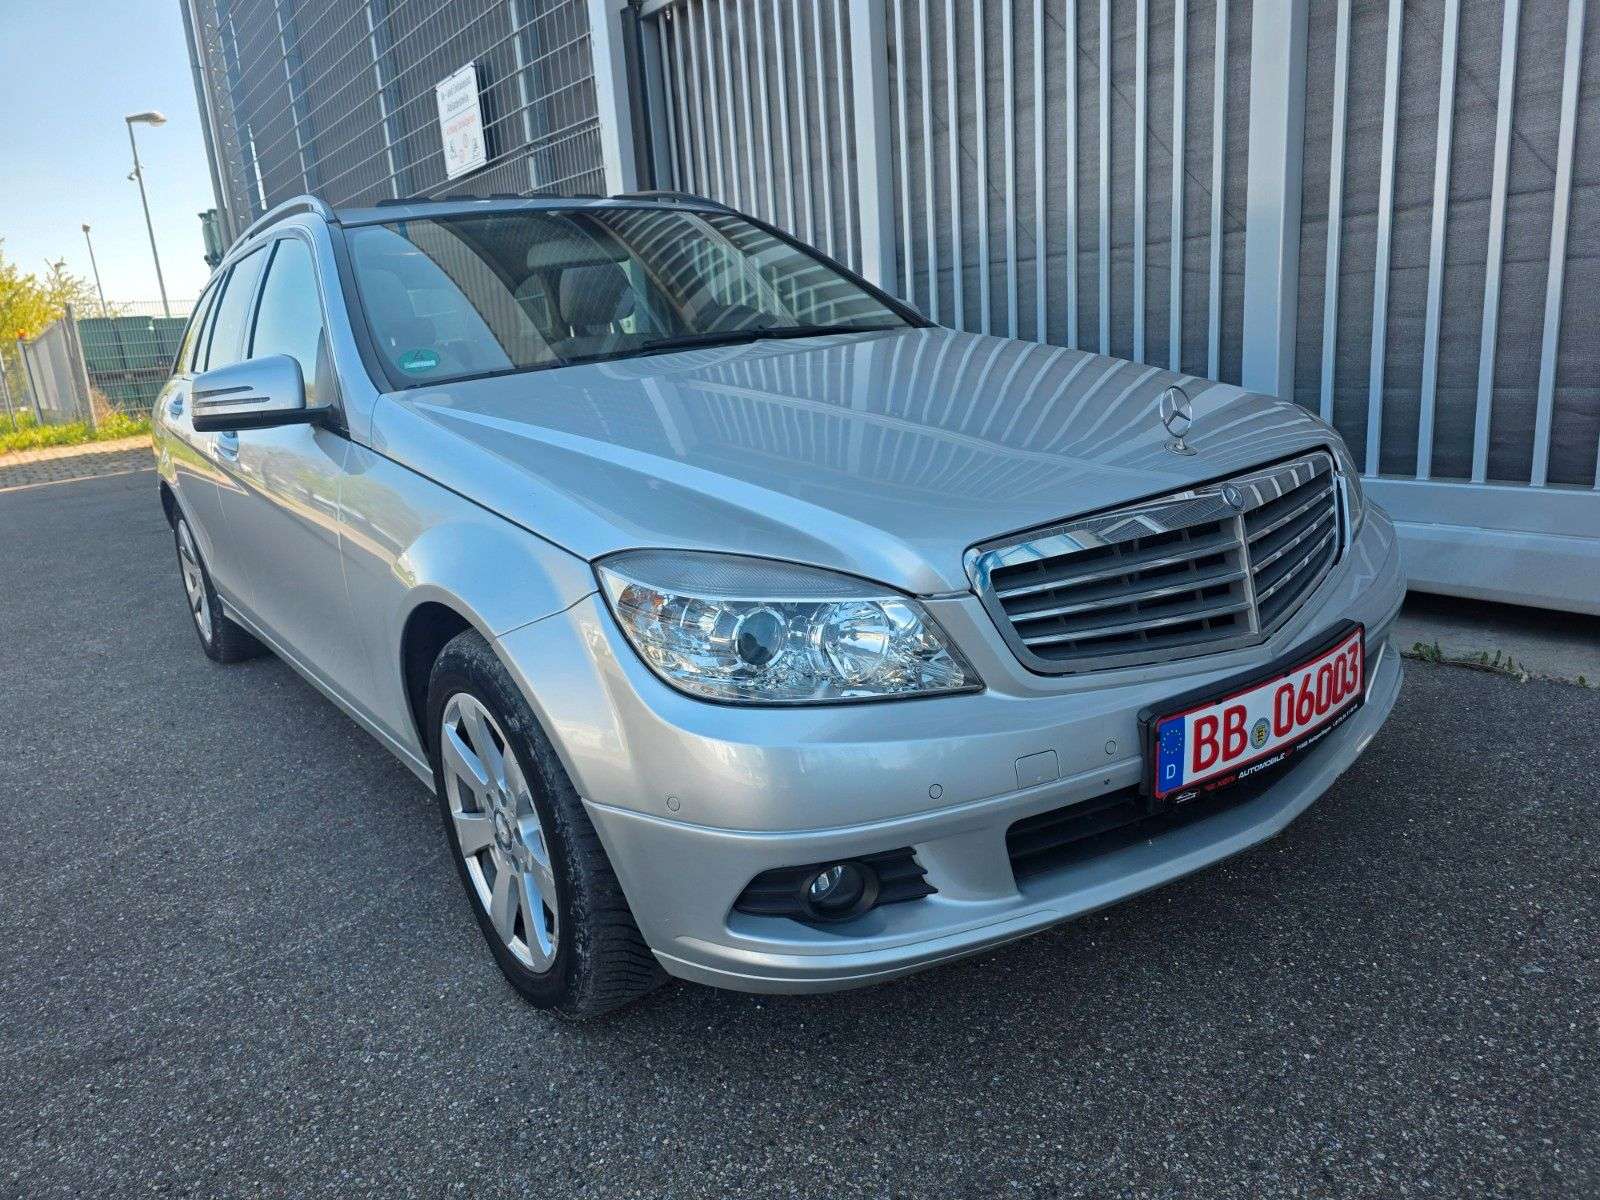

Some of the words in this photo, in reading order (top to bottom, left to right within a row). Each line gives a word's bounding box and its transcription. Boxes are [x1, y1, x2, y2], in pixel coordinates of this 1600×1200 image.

[1192, 704, 1249, 773] BB
[1273, 641, 1359, 738] 06003
[1165, 764, 1177, 780] D
[1238, 752, 1286, 779] AUTOMOBILE
